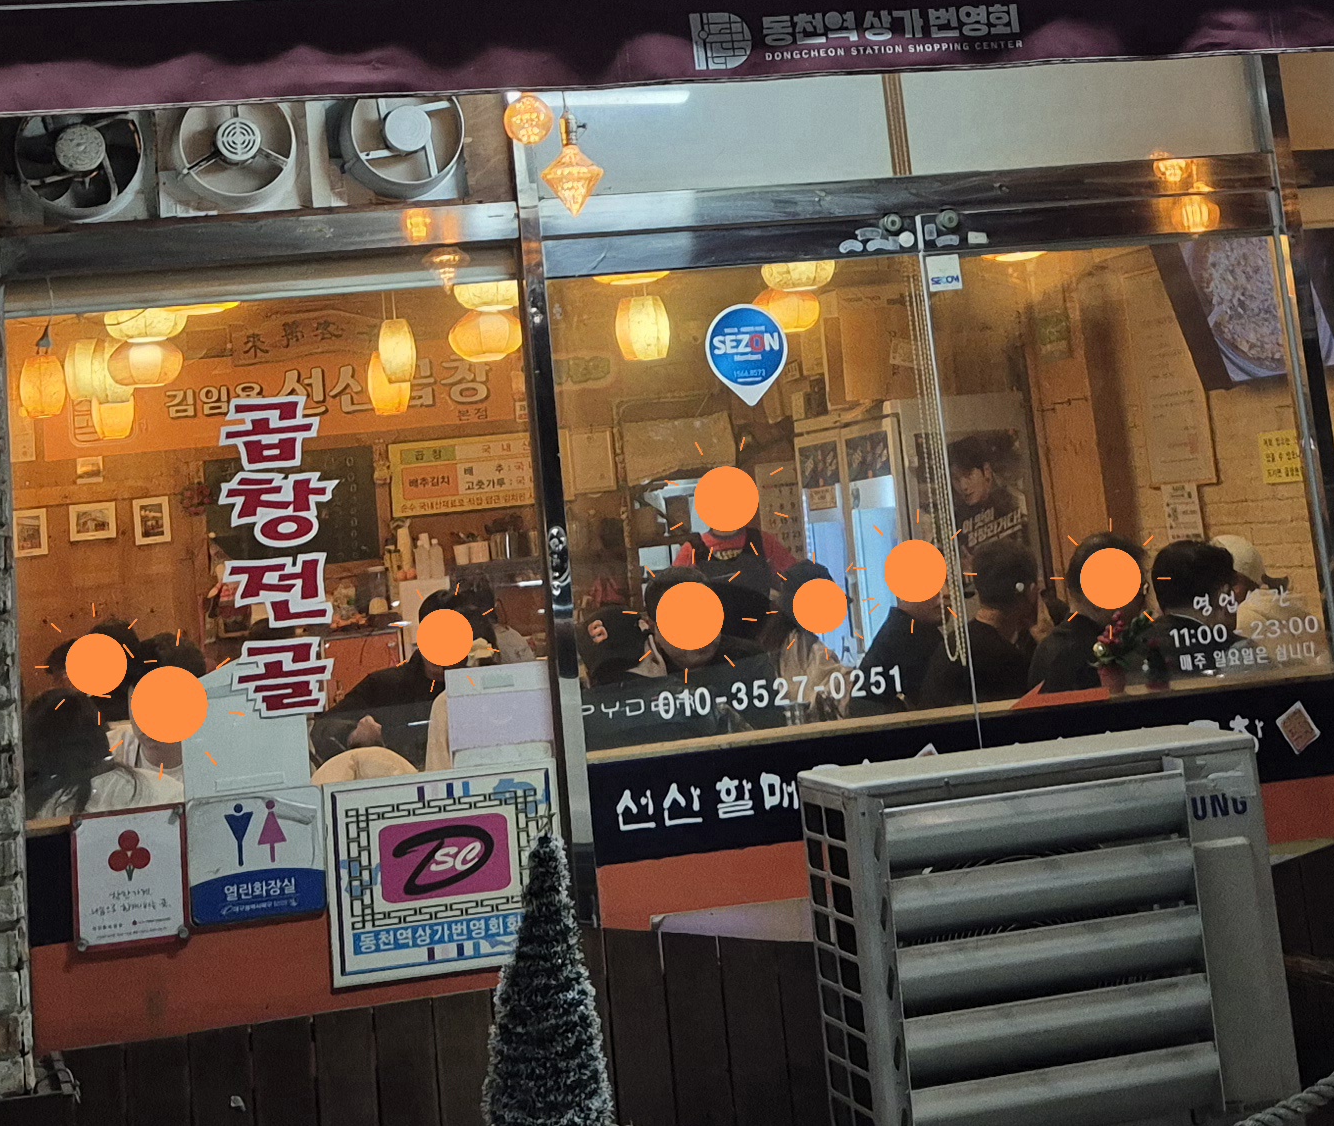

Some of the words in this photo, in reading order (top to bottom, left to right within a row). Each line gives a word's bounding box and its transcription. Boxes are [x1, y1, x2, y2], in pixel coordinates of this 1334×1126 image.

[762, 10, 859, 46] 동천역
[864, 7, 923, 41] 상가
[928, 3, 1021, 39] 번영회
[765, 47, 845, 62] DONGCHEON
[850, 44, 904, 57] STATION
[908, 42, 970, 54] SHOPPING
[974, 39, 1024, 51] CENTER
[712, 332, 780, 355] SEZON
[219, 396, 339, 719] 곱창전골
[1169, 623, 1228, 649] 11:00
[1250, 615, 1319, 640] 23:00
[1179, 652, 1207, 672] 매주
[1213, 646, 1269, 668] 일요일은
[657, 664, 905, 721] 010-3527-0251
[616, 782, 704, 832] 선산
[716, 771, 800, 820] 할매
[224, 876, 297, 902] 열린화장실
